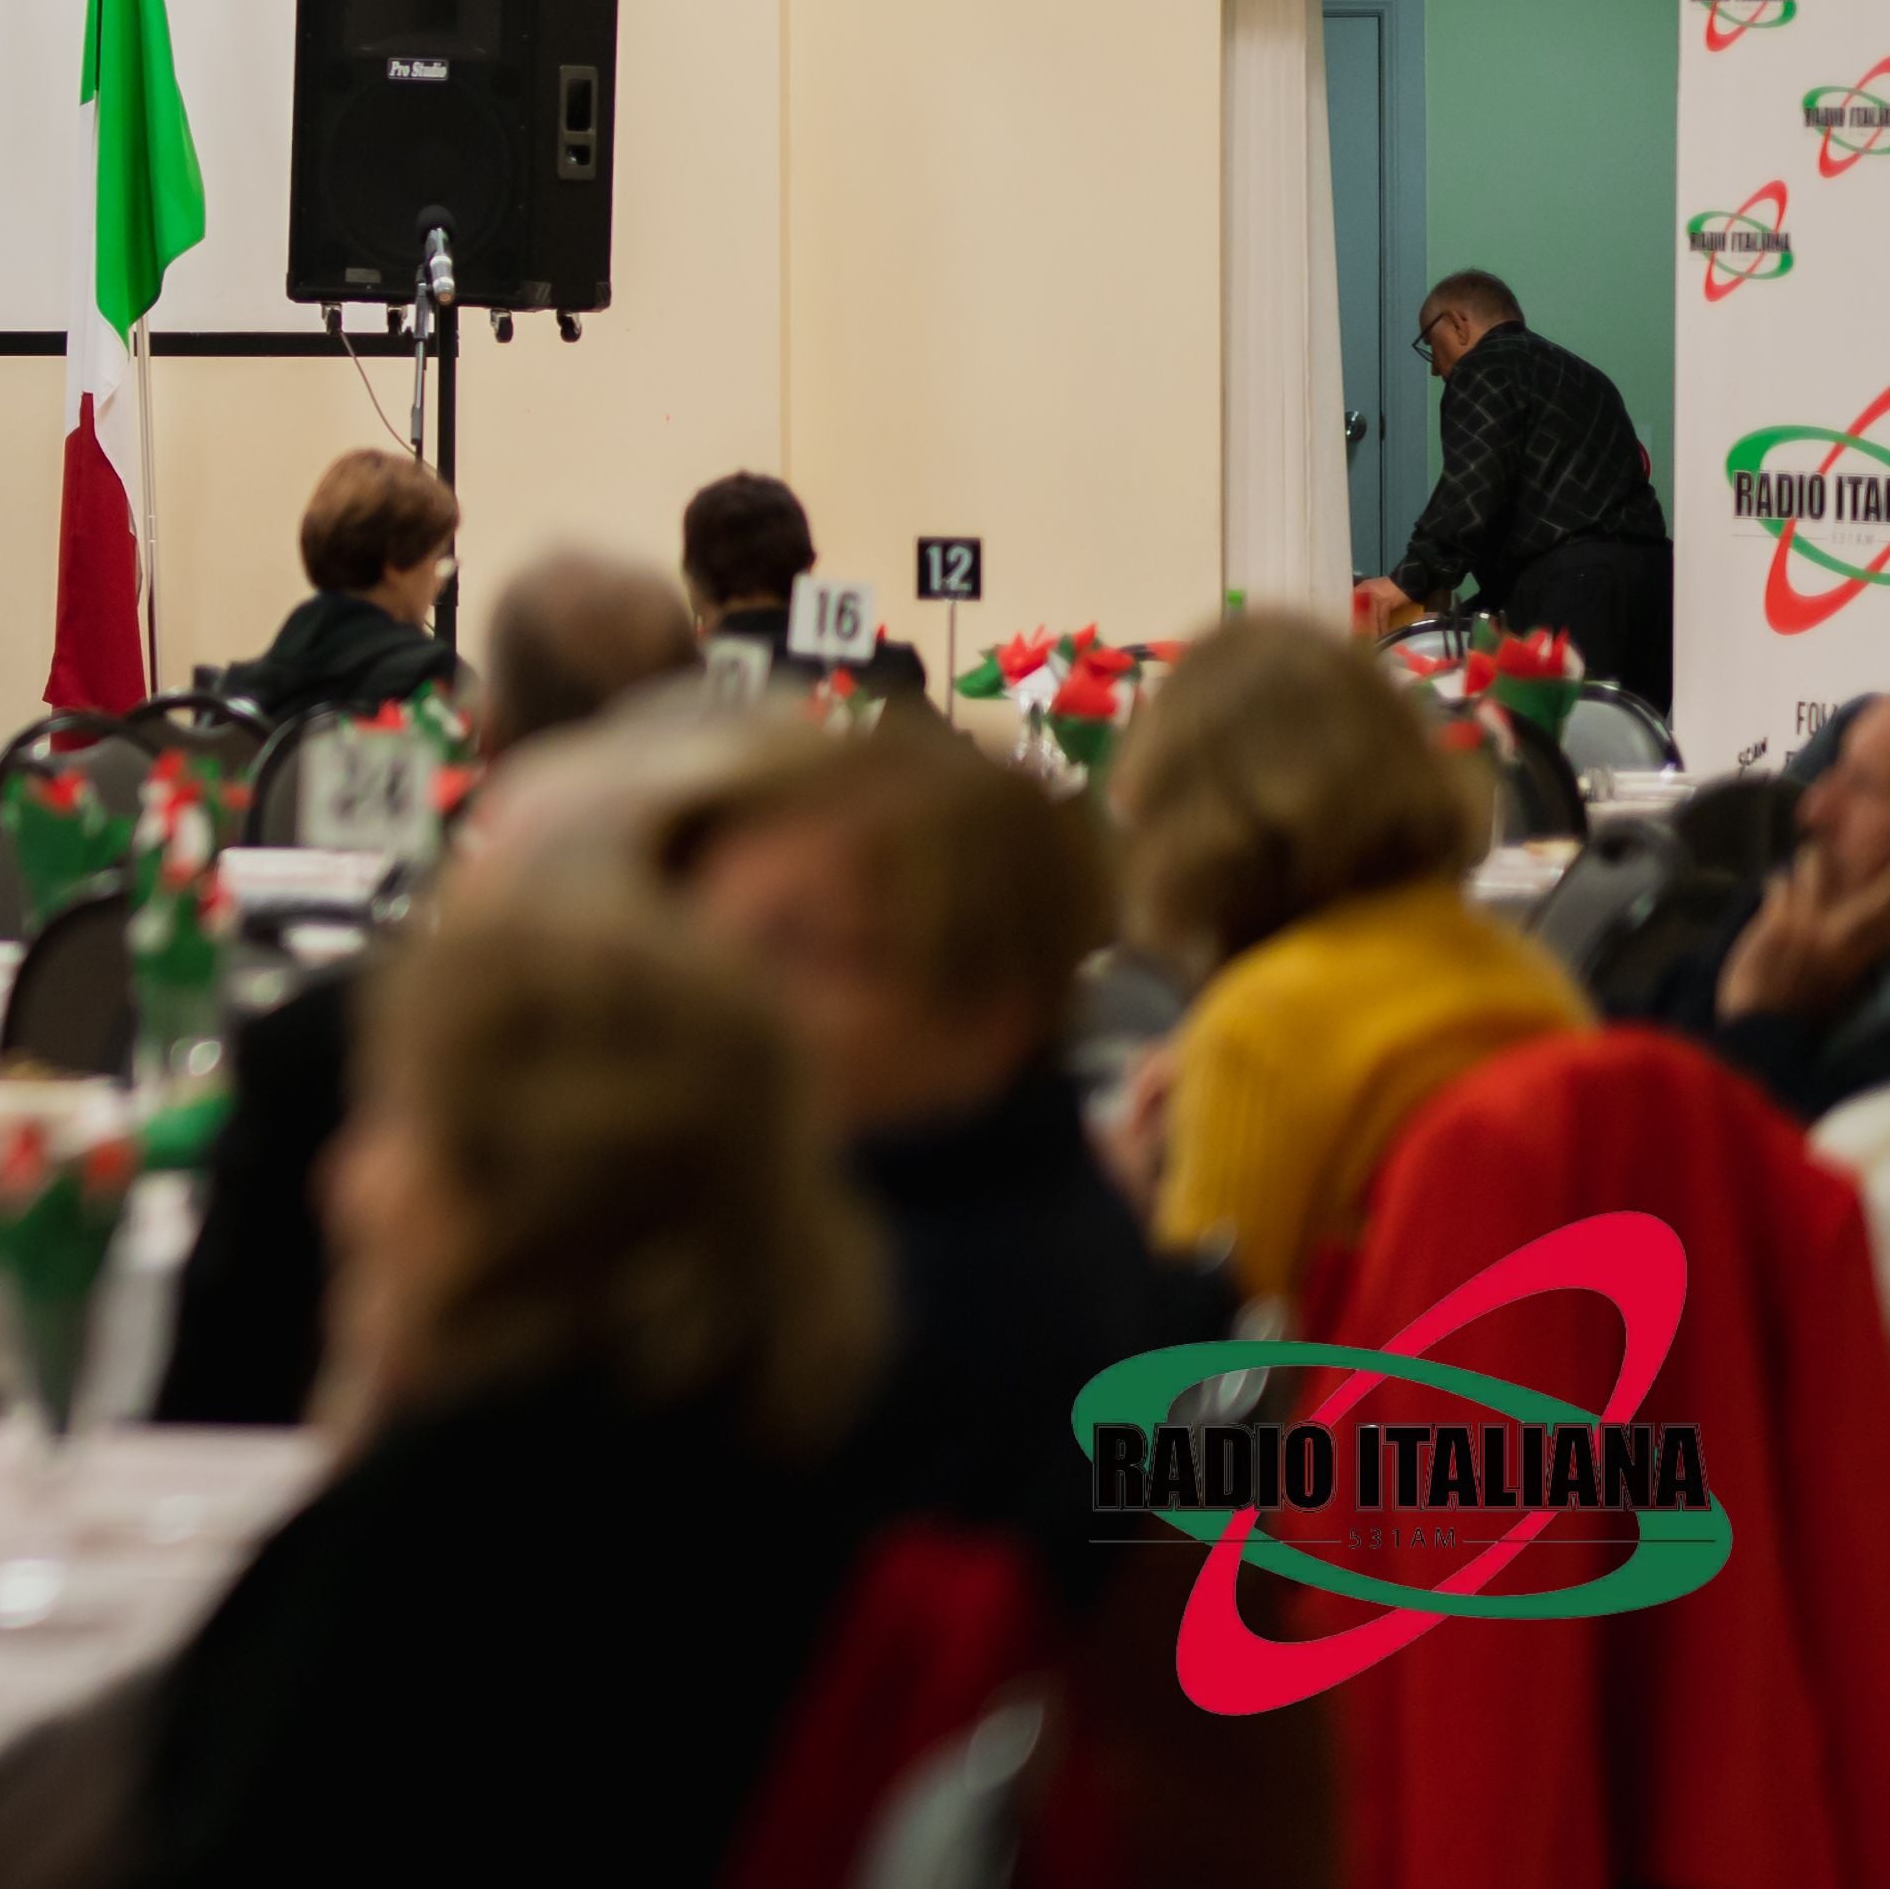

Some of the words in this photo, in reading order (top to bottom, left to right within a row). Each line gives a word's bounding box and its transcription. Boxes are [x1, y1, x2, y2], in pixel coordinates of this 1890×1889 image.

[388, 60, 410, 77] Pro
[411, 61, 447, 78] Studio
[1734, 470, 1825, 521] RADIO
[1836, 474, 1890, 523] ITA
[926, 543, 973, 593] 12
[816, 587, 861, 642] 16
